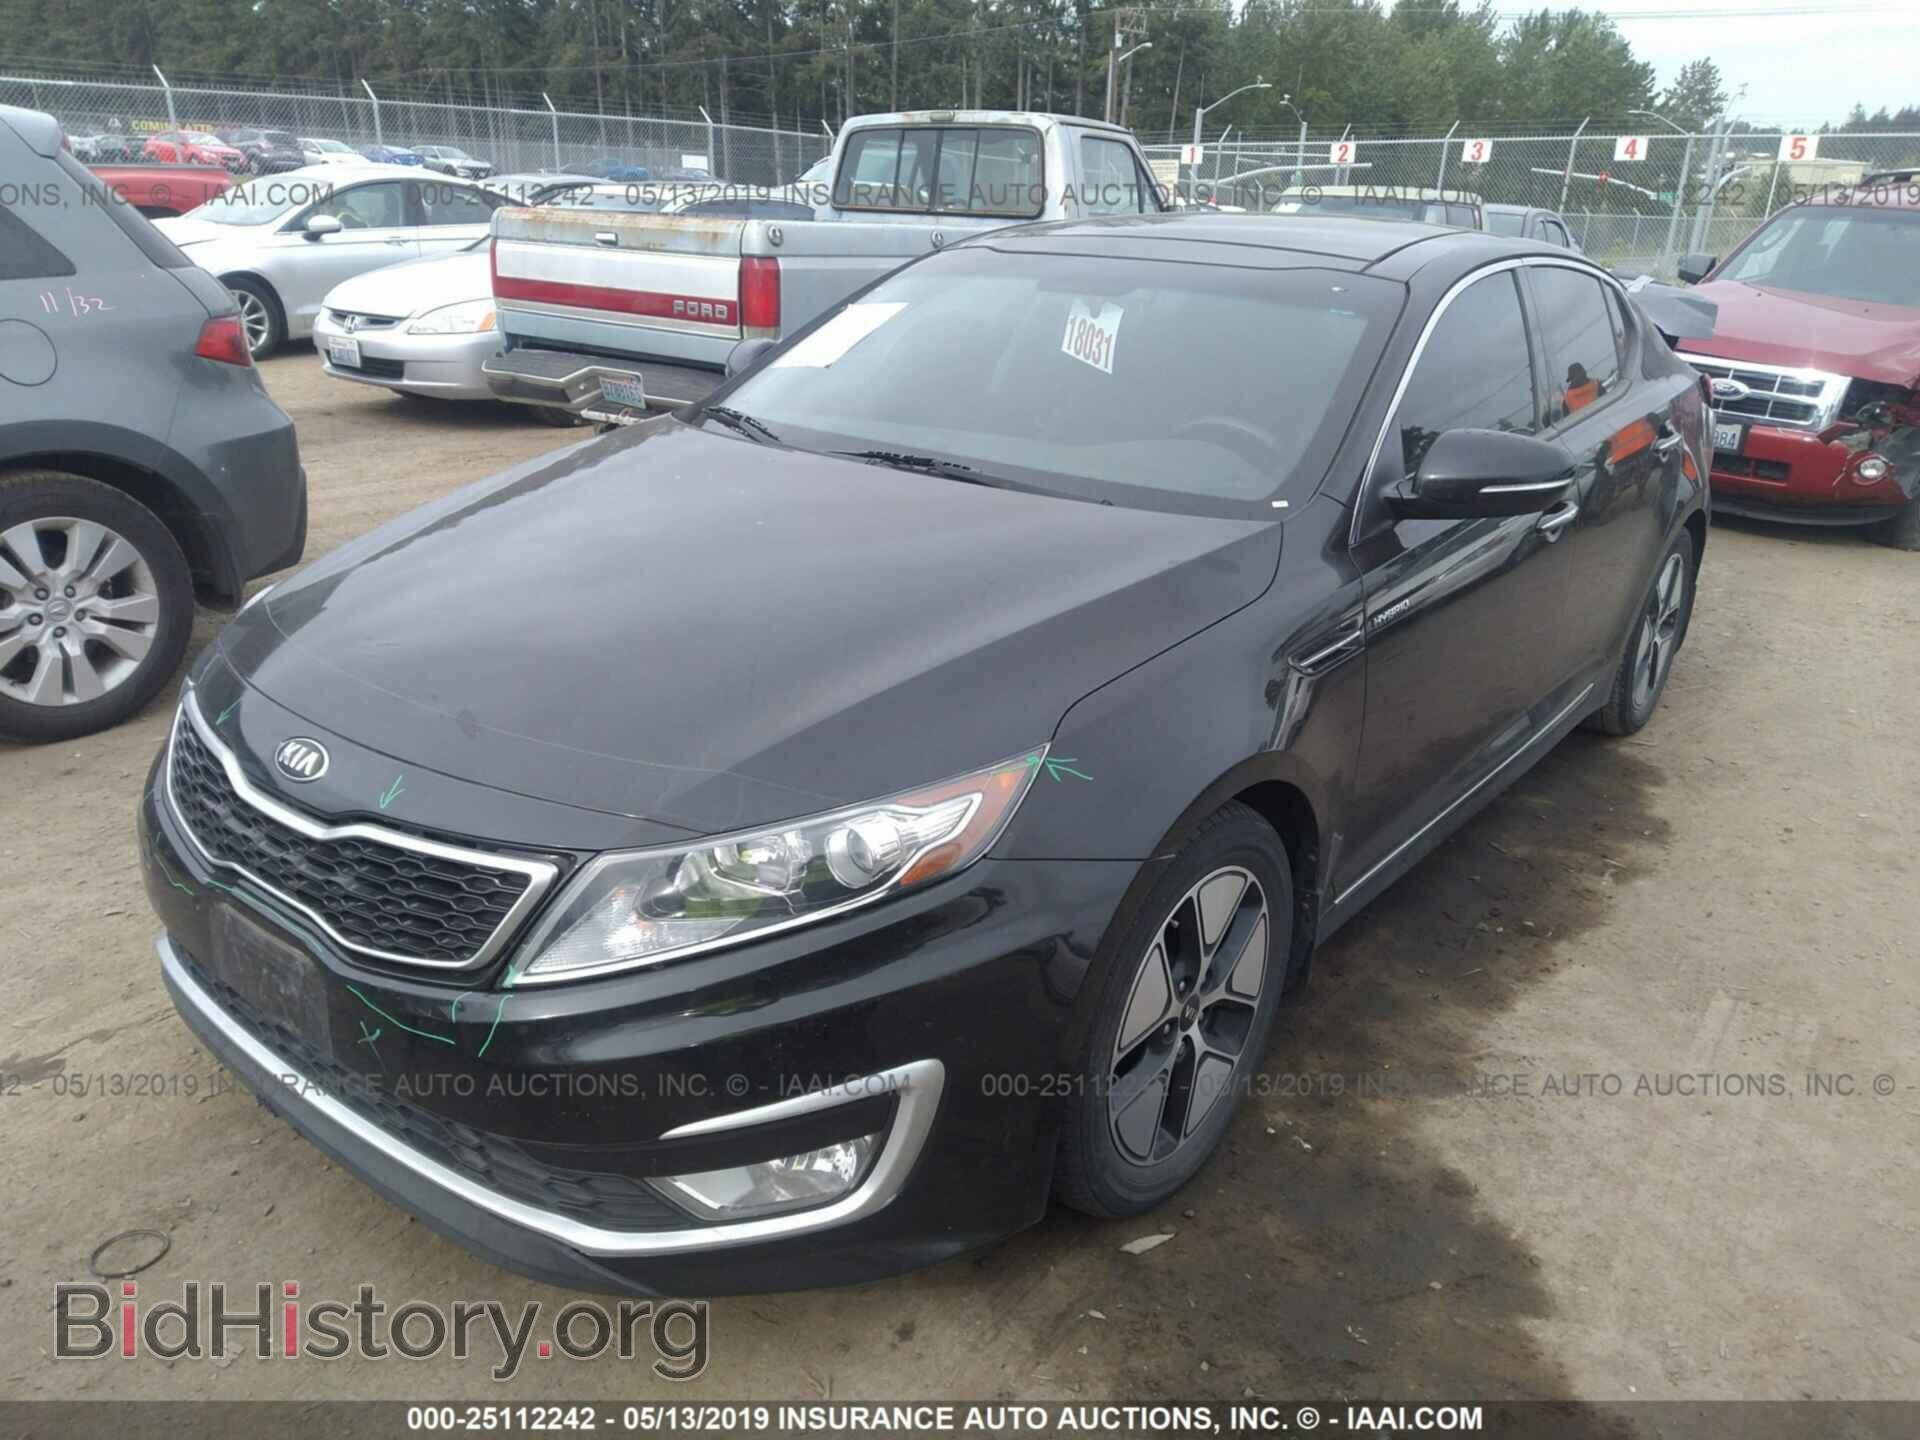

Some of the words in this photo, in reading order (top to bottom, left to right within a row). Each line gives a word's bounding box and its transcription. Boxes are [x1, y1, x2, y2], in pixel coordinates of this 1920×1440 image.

[1188, 146, 1197, 163] 1
[1337, 144, 1349, 162] 2
[1470, 140, 1485, 161] 3
[1623, 138, 1638, 159] 4
[1789, 136, 1808, 160] 5
[672, 299, 728, 320] FORD
[1066, 316, 1113, 369] 18031
[1373, 599, 1410, 625] HYBRID
